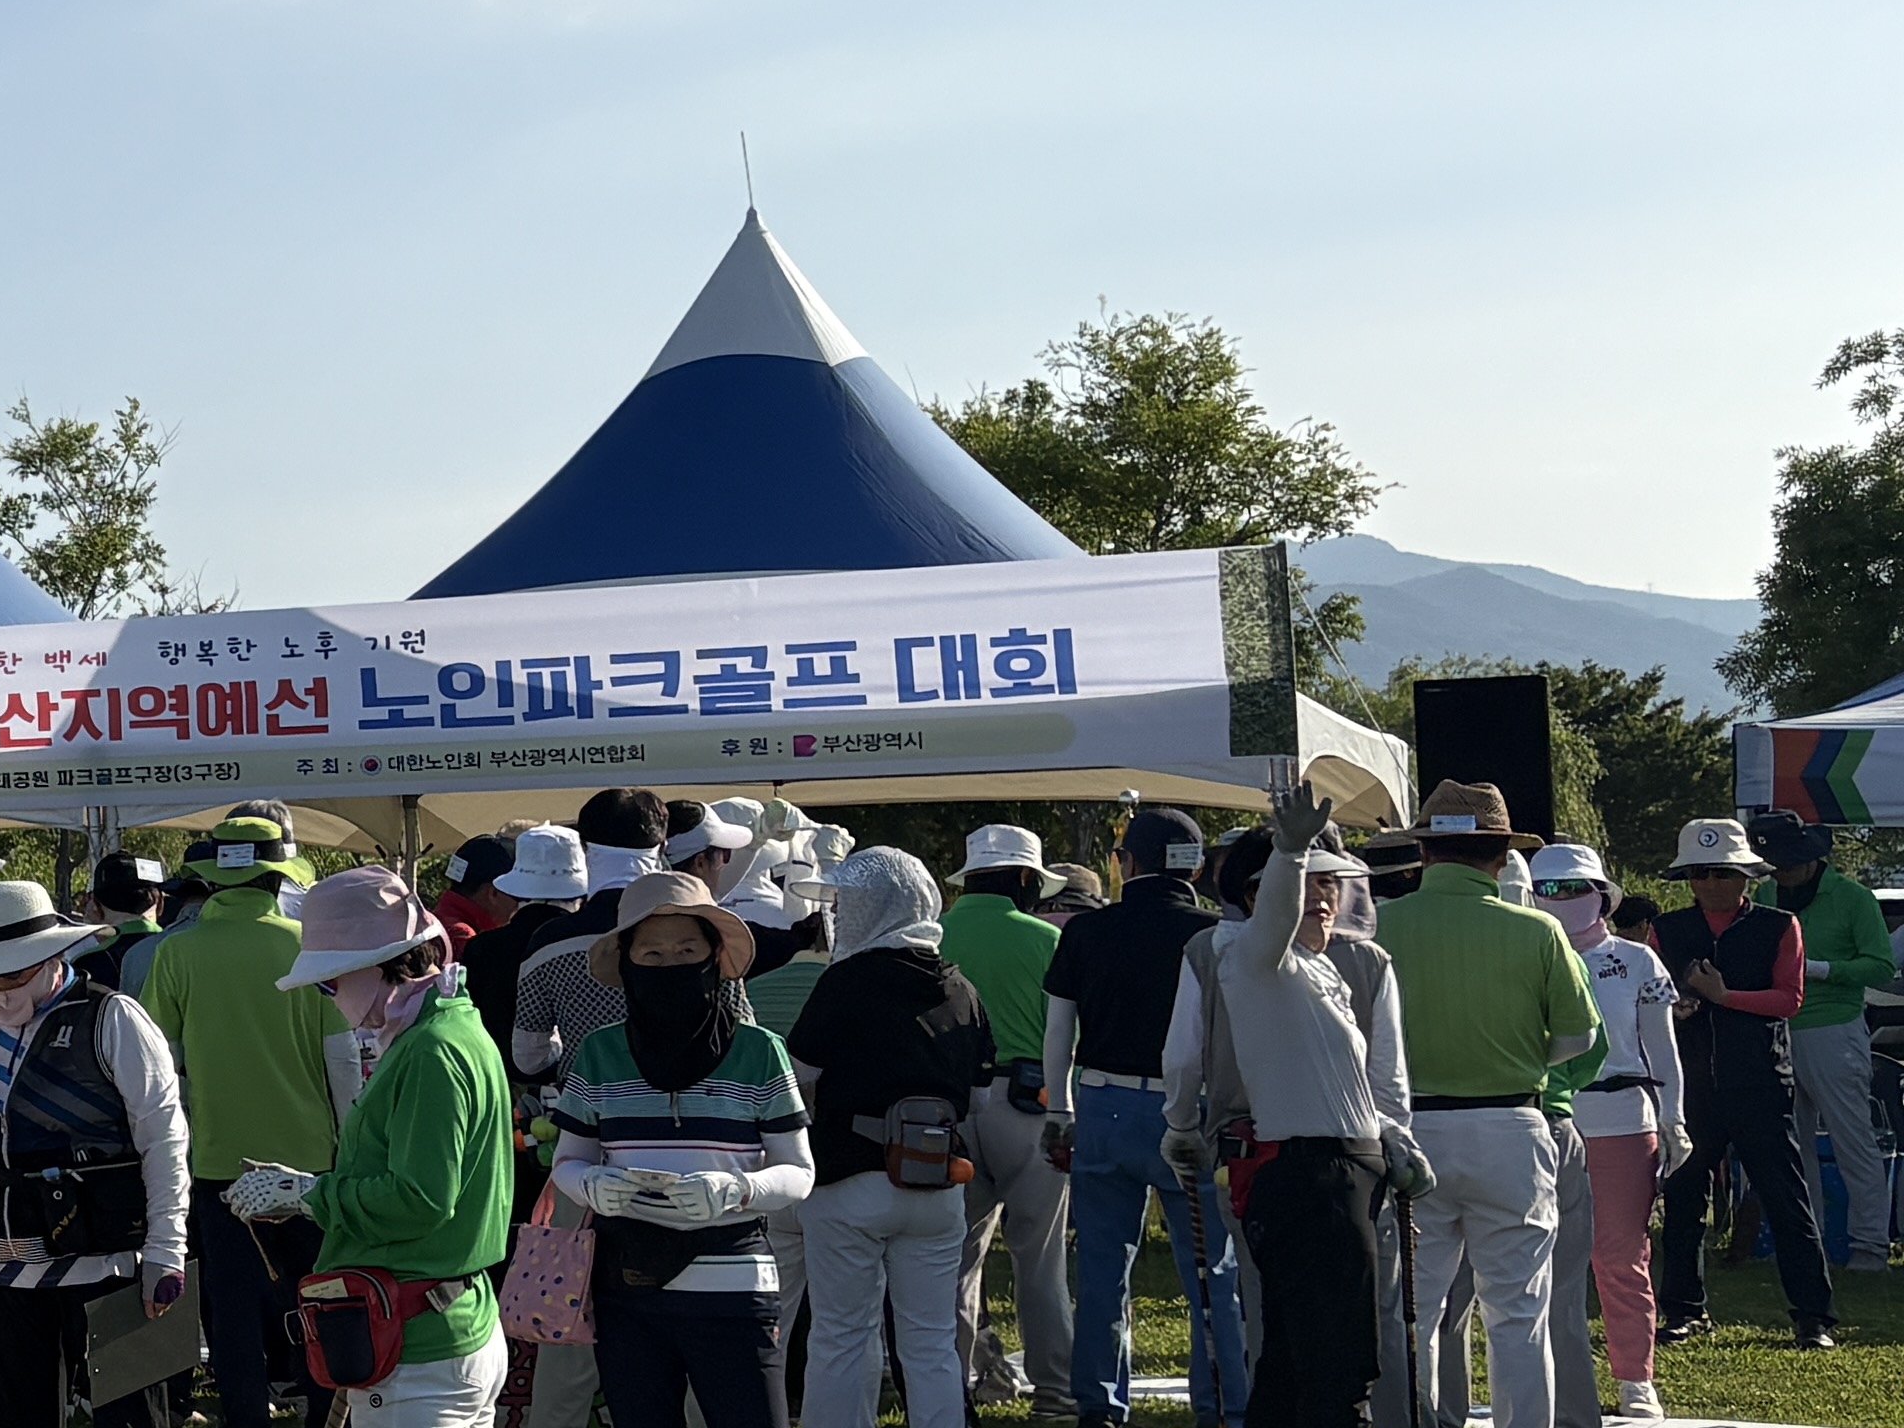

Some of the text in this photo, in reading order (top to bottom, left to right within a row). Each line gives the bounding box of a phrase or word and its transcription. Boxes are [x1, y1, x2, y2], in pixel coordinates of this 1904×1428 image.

[44, 648, 108, 669] 백세
[157, 636, 258, 667] 행복한
[280, 630, 339, 660] 노후
[363, 628, 427, 655] 기원
[358, 639, 868, 730] 노인파크골프
[893, 626, 1079, 704] 대회
[387, 750, 482, 773] 대한노인회
[488, 743, 646, 769] 부산광역시연합회
[821, 731, 923, 753] 부산광역시
